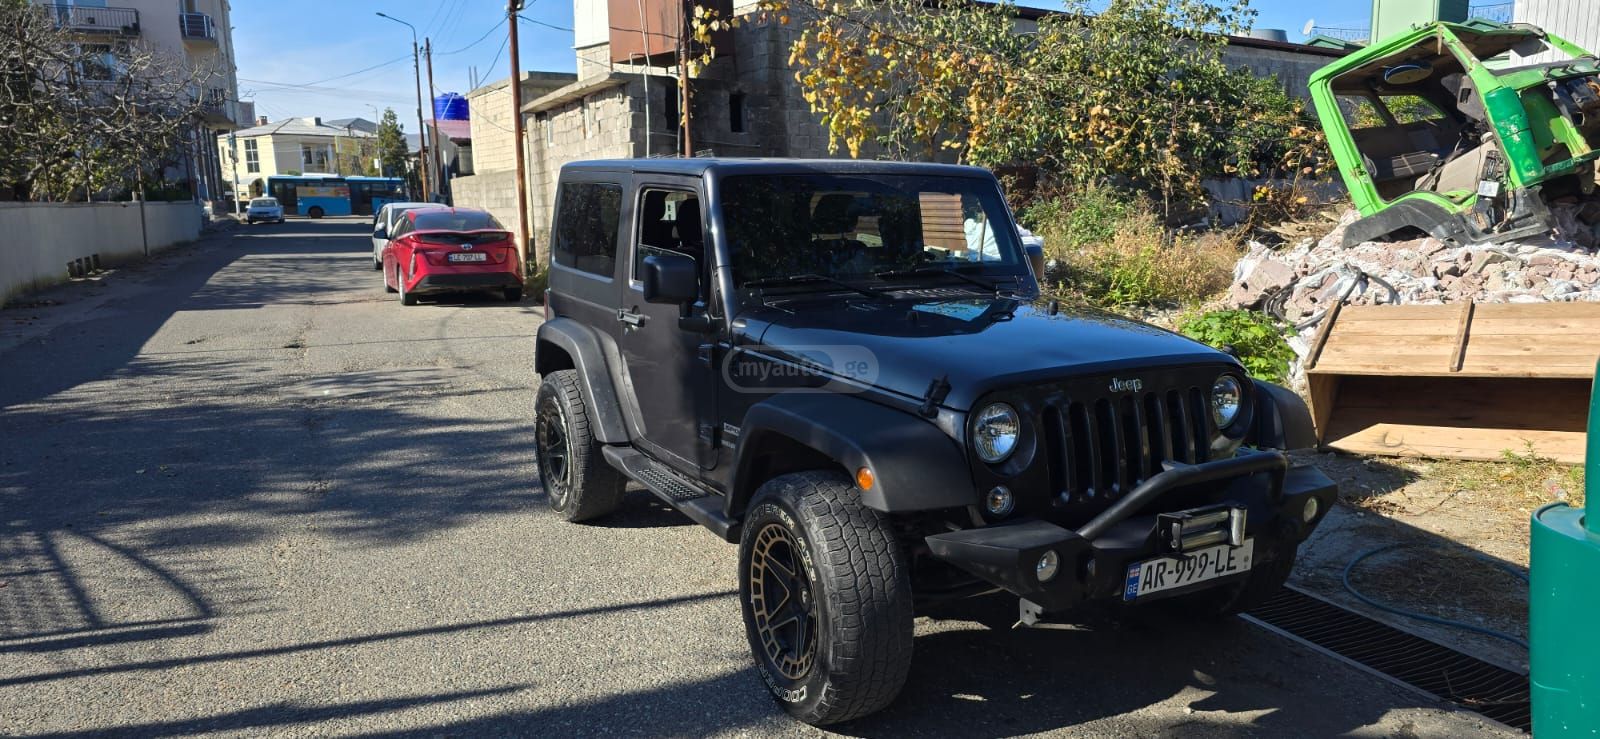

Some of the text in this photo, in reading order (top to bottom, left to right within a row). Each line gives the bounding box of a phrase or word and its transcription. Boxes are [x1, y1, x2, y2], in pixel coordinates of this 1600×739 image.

[1109, 378, 1142, 393] Jeep
[1127, 546, 1238, 595] GE AR-999-LE
